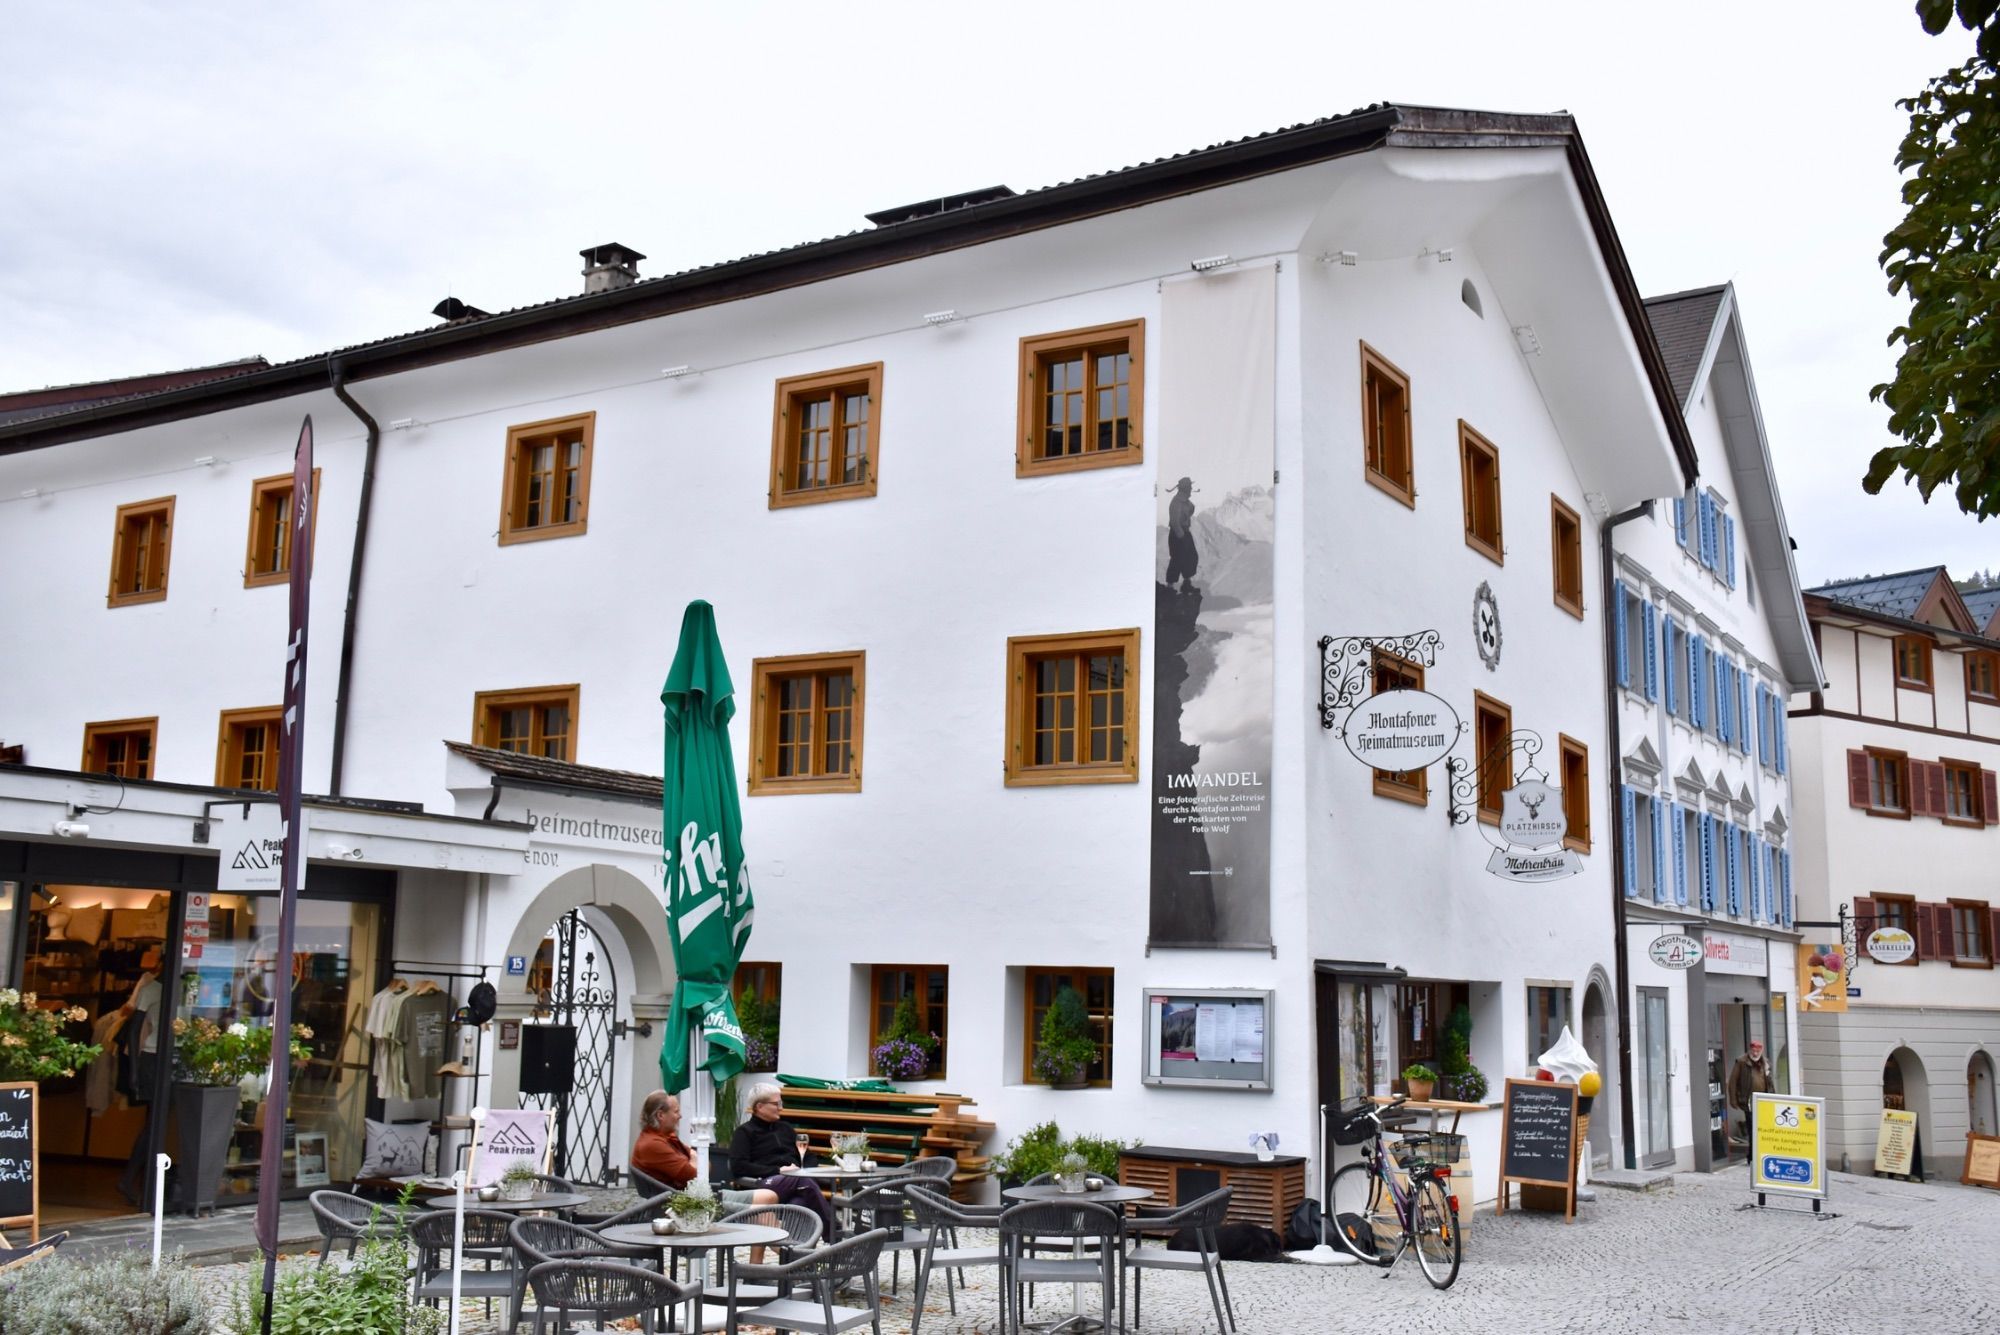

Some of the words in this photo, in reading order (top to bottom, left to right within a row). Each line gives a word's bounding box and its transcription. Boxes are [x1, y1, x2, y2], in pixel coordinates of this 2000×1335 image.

[1367, 711, 1437, 731] Montafoner
[1357, 733, 1445, 753] Heimatmuseum
[1158, 796, 1176, 804] Eine
[1176, 795, 1229, 805] fotografische
[1230, 794, 1265, 802] Zeitreise
[1162, 806, 1189, 814] durchs
[1190, 805, 1229, 814] Montafon
[1230, 804, 1261, 812] anhand
[1188, 815, 1230, 823] Postkarten
[527, 809, 663, 846] heimatmuseu
[1211, 825, 1230, 833] Wolf
[1506, 822, 1561, 831] PLATZHIRSCH
[1504, 857, 1565, 870] Mohrenbräu
[1655, 936, 1697, 949] Apotheke
[511, 957, 523, 969] 15
[1657, 957, 1696, 968] Pharmacy
[488, 1145, 510, 1154] Peak
[511, 1146, 536, 1155] Freak
